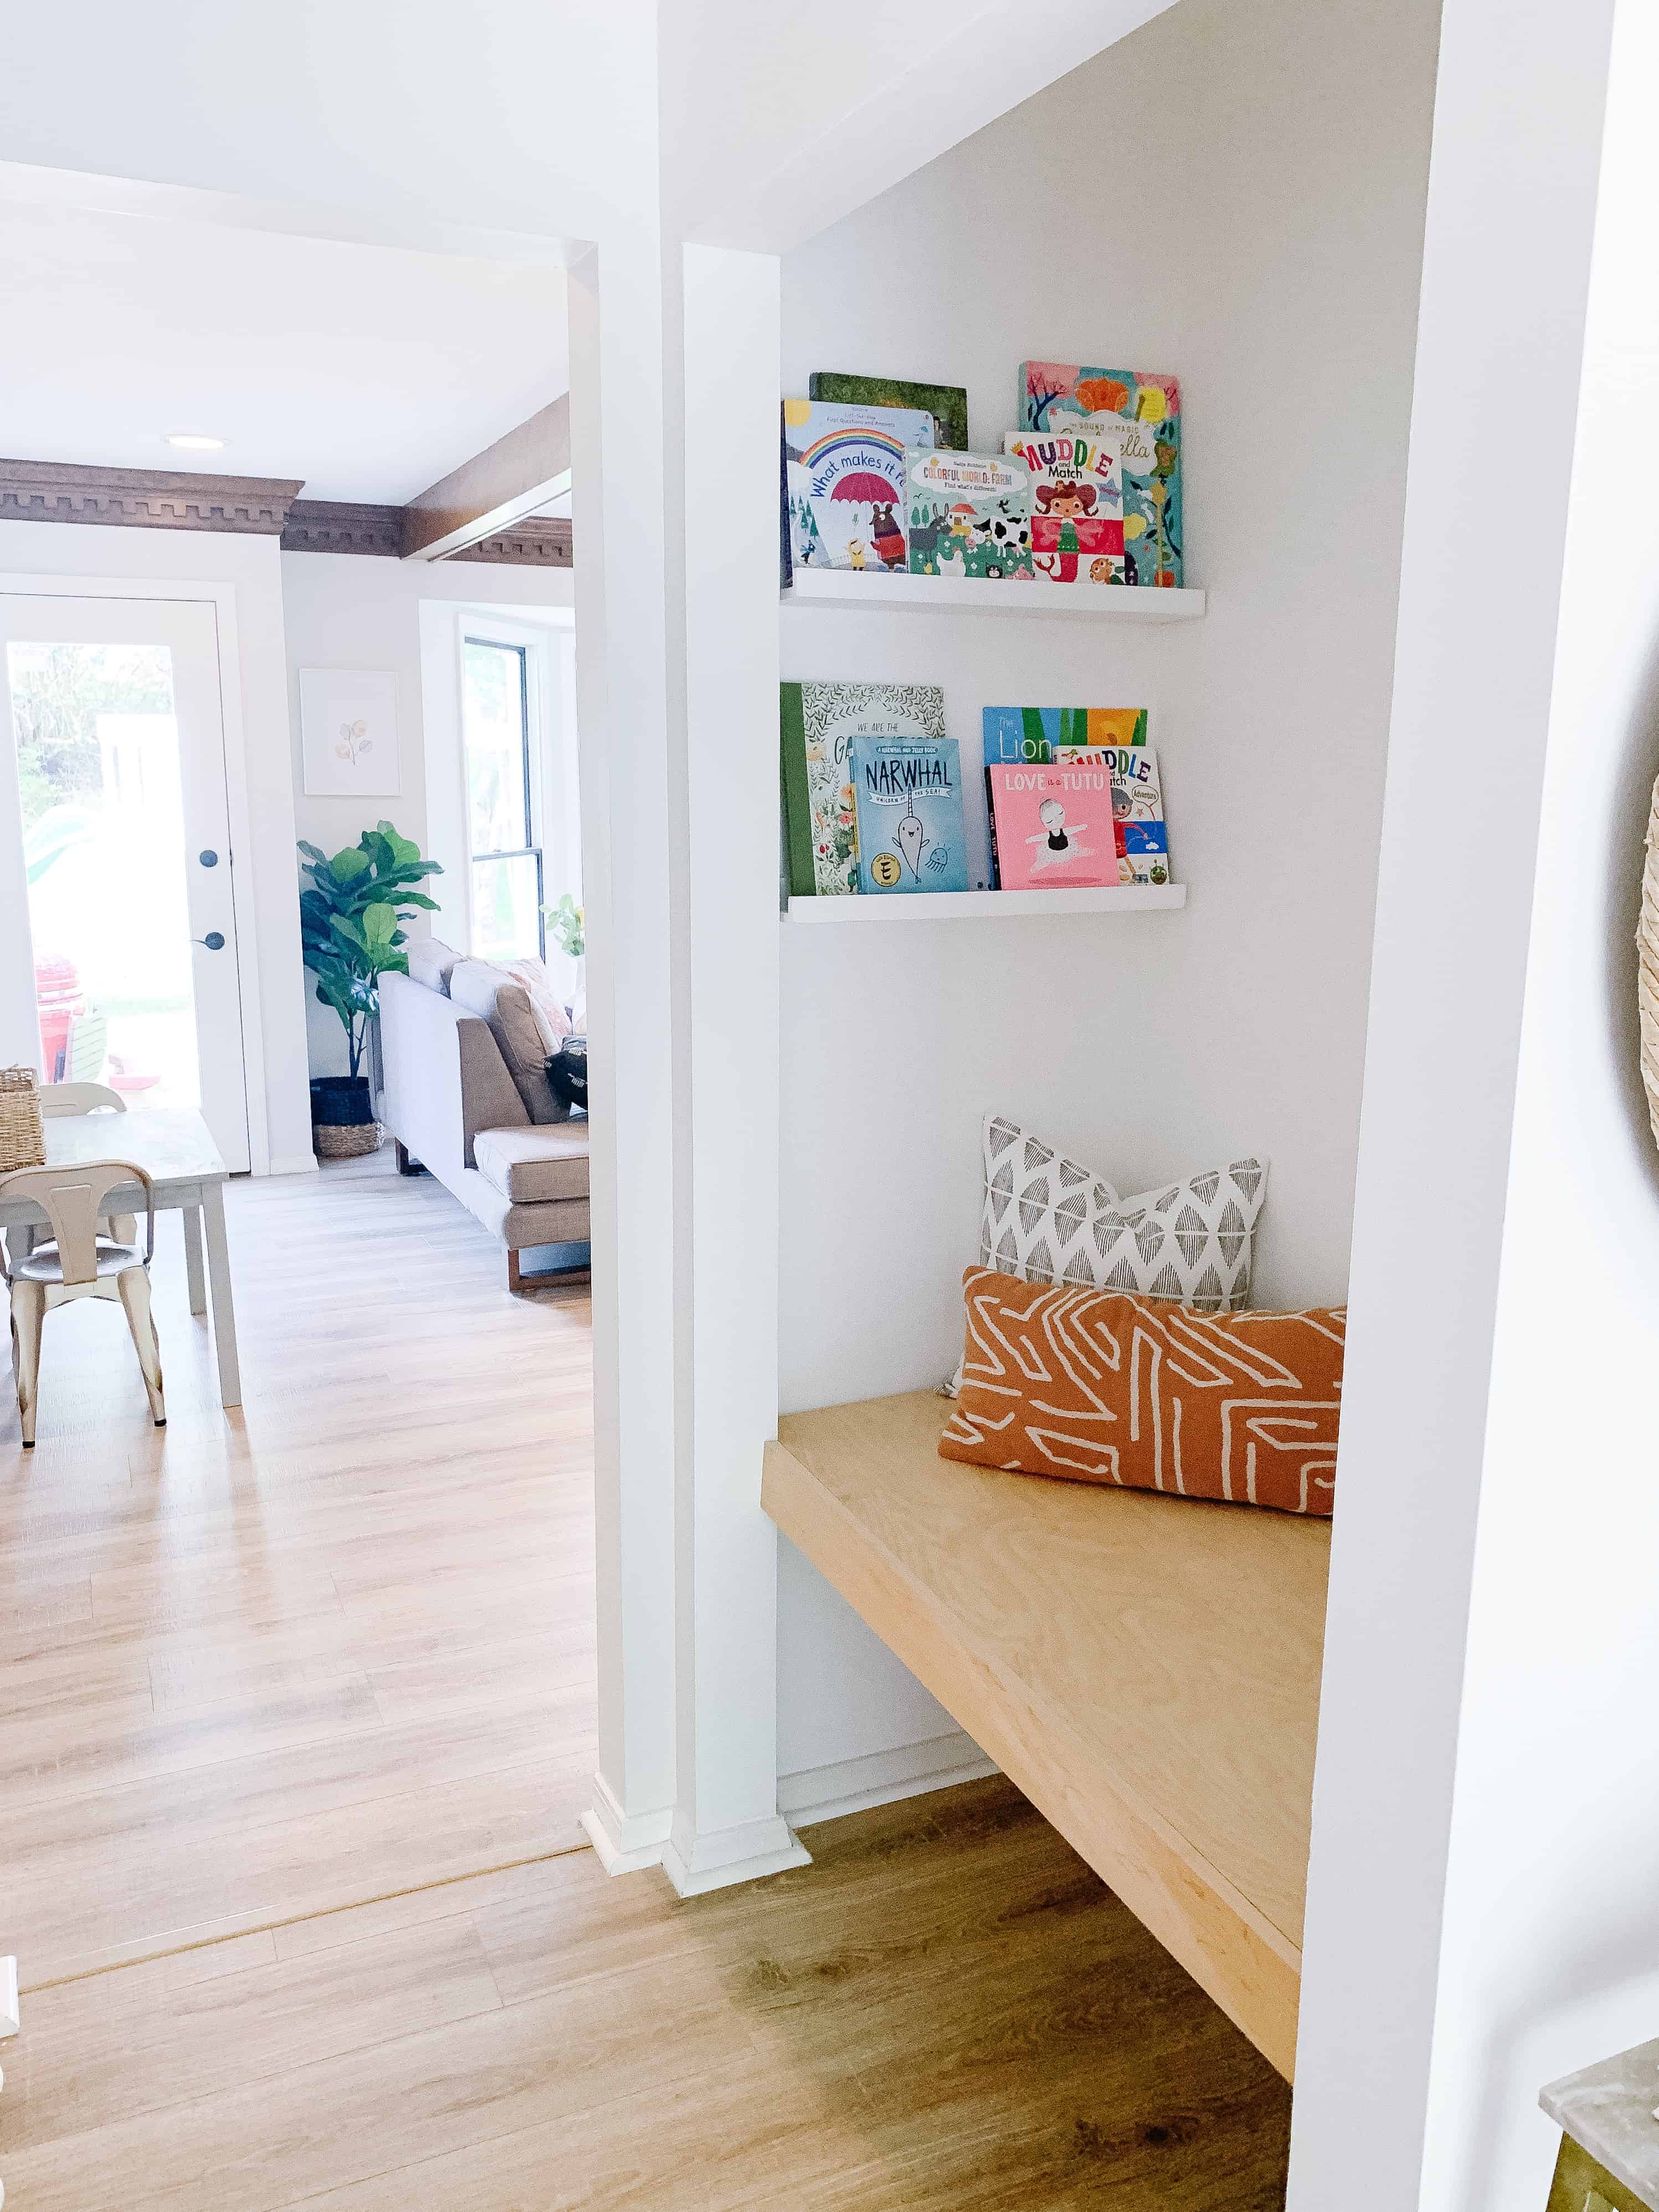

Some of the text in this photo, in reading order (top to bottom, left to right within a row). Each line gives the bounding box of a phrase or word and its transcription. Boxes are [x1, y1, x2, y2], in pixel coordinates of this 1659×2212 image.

[1079, 421, 1105, 431] SOUND
[1115, 424, 1139, 434] MAGIC
[1013, 439, 1113, 477] MUDDLE
[810, 450, 896, 497] What makes it
[923, 466, 1012, 486] COLORFUL WORLD: FARM
[1049, 465, 1082, 479] Match
[857, 722, 900, 732] WE ARE THE
[999, 729, 1052, 759] Lion
[866, 758, 952, 795] NARWHAL
[1005, 772, 1046, 791] LOVE
[1062, 772, 1105, 791] TUTU
